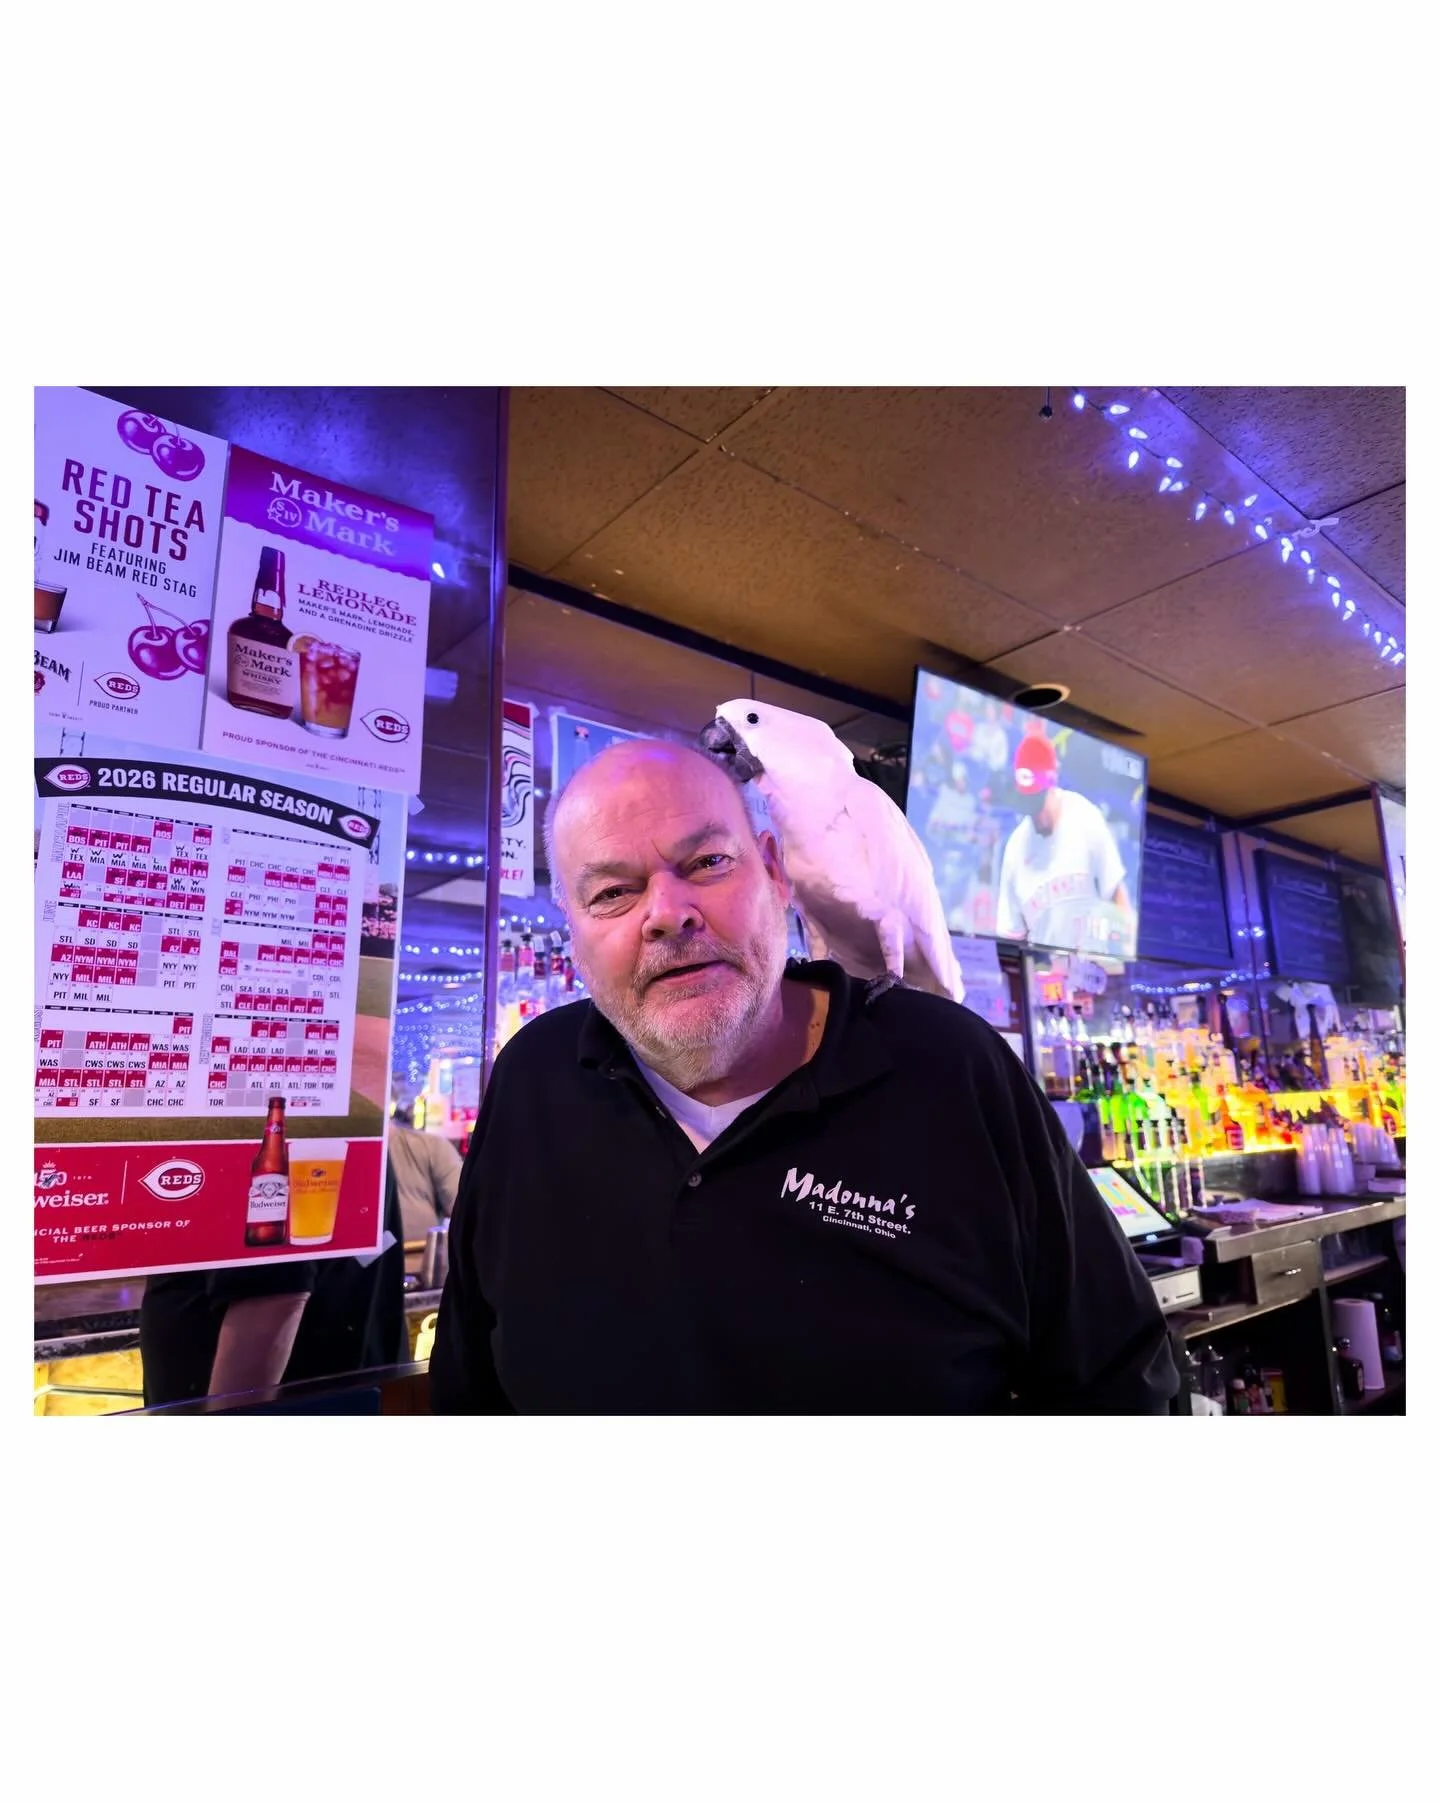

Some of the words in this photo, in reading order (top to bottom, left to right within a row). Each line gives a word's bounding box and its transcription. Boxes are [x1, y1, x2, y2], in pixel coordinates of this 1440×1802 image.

[62, 458, 132, 509] RED
[145, 484, 205, 533] TEA
[269, 471, 400, 533] Maker's
[276, 501, 285, 511] S
[74, 499, 188, 561] SHOTS
[304, 509, 396, 557] Mark
[91, 542, 167, 575] FEATURING
[54, 548, 81, 566] JIM
[86, 556, 126, 578] BEAM
[132, 569, 158, 587] RED
[163, 578, 197, 598] STAG
[317, 579, 400, 612] REDLEG
[298, 583, 417, 626] LEMONADE
[298, 598, 337, 614] MAKER'S
[299, 607, 317, 617] AND
[328, 615, 377, 634] GRENADINE
[379, 629, 413, 643] DRIZZLE
[235, 643, 293, 666] Maker's
[250, 658, 292, 677] Mark
[108, 680, 139, 694] REDS
[89, 700, 110, 710] PROUD
[112, 704, 139, 715] PARTNER
[376, 719, 409, 735] REDS
[222, 731, 253, 744] PROUD
[255, 739, 296, 753] SPONSOR
[311, 751, 328, 760] THE
[330, 754, 377, 769] CINCINNATI
[58, 772, 90, 782] REDS
[97, 767, 157, 790] 2026
[163, 772, 256, 804] REGULAR
[260, 788, 333, 826] SEASON
[348, 820, 372, 835] REDS
[68, 835, 85, 845] BOS
[95, 838, 108, 847] PIT
[115, 841, 129, 850] PIT
[136, 844, 150, 853] PIT
[501, 837, 526, 848] TY.
[70, 853, 84, 862] TEX
[90, 856, 105, 865] MIA
[110, 858, 126, 867] MIA
[132, 861, 147, 870] MIA
[153, 864, 167, 873] MIA
[66, 871, 82, 880] LAA
[114, 876, 125, 885] SF
[173, 865, 188, 874] LAA
[171, 883, 186, 892] MIN
[191, 886, 205, 894] MIN
[87, 919, 98, 928] KC
[108, 921, 120, 930] KC
[129, 922, 141, 932] KC
[168, 927, 180, 936] STL
[59, 935, 73, 944] STL
[84, 937, 96, 946] SD
[106, 939, 117, 947] SD
[127, 941, 138, 949] SD
[169, 944, 180, 953] AZ
[60, 954, 71, 962] AZ
[74, 955, 94, 964] NYM
[96, 957, 115, 965] NYM
[118, 959, 137, 967] NYM
[162, 962, 178, 970] NYY
[53, 972, 69, 981] NYY
[76, 974, 92, 982] MIL
[98, 975, 113, 984] MIL
[119, 977, 134, 985] MIL
[163, 980, 175, 988] PIT
[183, 981, 195, 989] PIT
[54, 991, 67, 999] PIT
[73, 992, 88, 1000] MIL
[96, 993, 111, 1002] MIL
[178, 1026, 191, 1034] PIT
[47, 1039, 61, 1048] PIT
[89, 1041, 106, 1049] ATH
[110, 1041, 127, 1050] ATH
[132, 1042, 149, 1050] ATH
[152, 1043, 169, 1051] WAS
[172, 1044, 189, 1052] WAS
[234, 1046, 248, 1054] LAD
[39, 1059, 59, 1067] WAS
[85, 1060, 104, 1068] CWS
[106, 1060, 125, 1068] CWS
[128, 1061, 146, 1069] CWS
[152, 1061, 167, 1069] MIA
[172, 1062, 187, 1070] MIA
[231, 1063, 246, 1071] LAD
[39, 1078, 56, 1087] MIA
[64, 1079, 79, 1087] STL
[86, 1079, 100, 1087] STL
[108, 1079, 123, 1087] STL
[130, 1079, 144, 1087] STL
[155, 1080, 166, 1088] AZ
[175, 1080, 186, 1088] AZ
[209, 1081, 226, 1089] CHC
[146, 1098, 164, 1106] CHC
[209, 1098, 224, 1106] TOR
[160, 1174, 203, 1186] REDS
[780, 1167, 917, 1220] Madonna's
[250, 1201, 286, 1209] Budweiser
[809, 1201, 823, 1211] 11
[827, 1205, 839, 1215] E.
[844, 1209, 865, 1222] 7th
[868, 1215, 911, 1234] Street.
[74, 1225, 107, 1234] BEER
[112, 1221, 171, 1232] SPONSOR
[175, 1219, 191, 1229] OF
[822, 1215, 872, 1233] Cincinnati,
[874, 1227, 896, 1239] Ohio
[53, 1235, 77, 1243] THE
